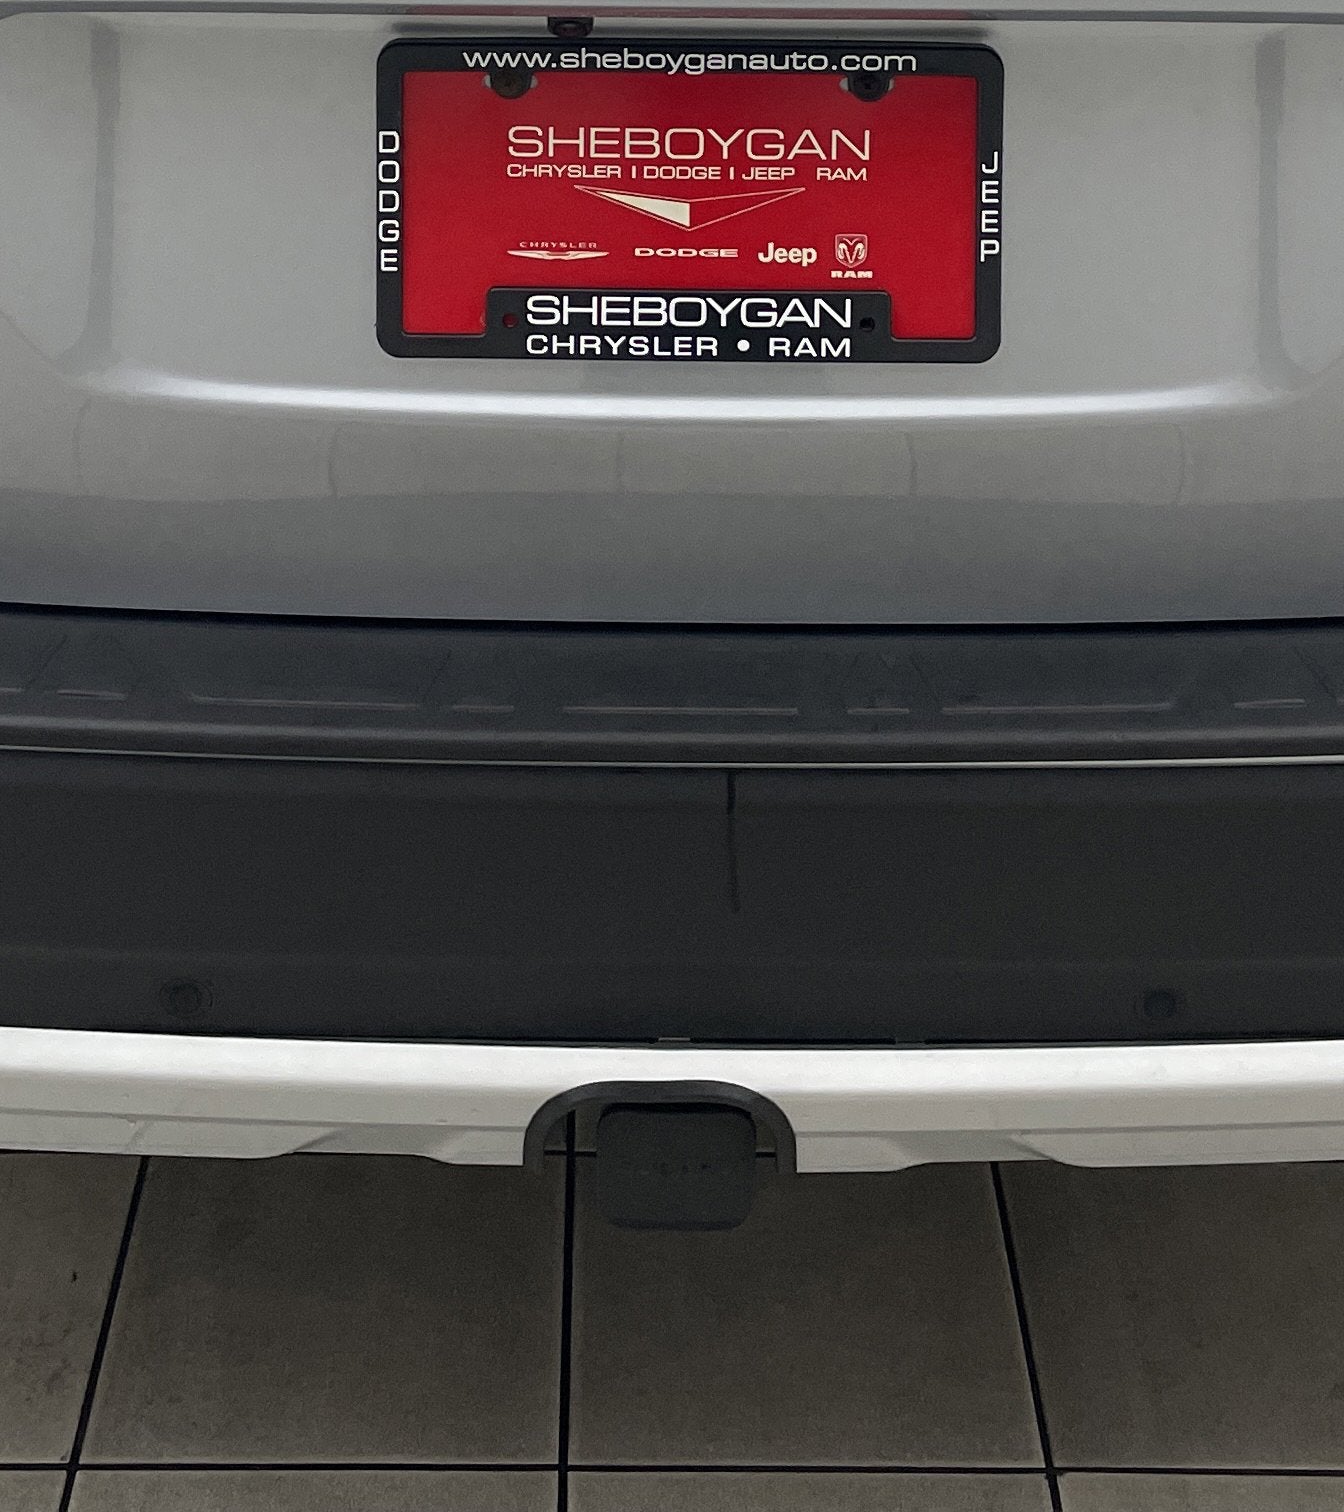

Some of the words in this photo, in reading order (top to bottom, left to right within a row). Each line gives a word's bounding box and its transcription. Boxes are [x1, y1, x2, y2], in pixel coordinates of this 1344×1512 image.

[461, 48, 918, 75] www.sheboyganauto.com
[507, 125, 871, 161] SHEBOYGAN
[506, 164, 622, 179] CHRYSLER
[643, 165, 722, 180] DODGE
[741, 167, 795, 181] JEEP
[816, 167, 867, 181] RAM
[378, 131, 399, 271] DODGE
[980, 152, 1000, 262] JEEP
[519, 241, 598, 249] CHRYSLER
[634, 247, 739, 258] DODGE
[758, 241, 818, 267] Jeep
[830, 270, 873, 279] RAM
[526, 295, 852, 328] SHEBOYGAN
[526, 335, 718, 357] CHRYSLER
[769, 337, 851, 358] RAM
